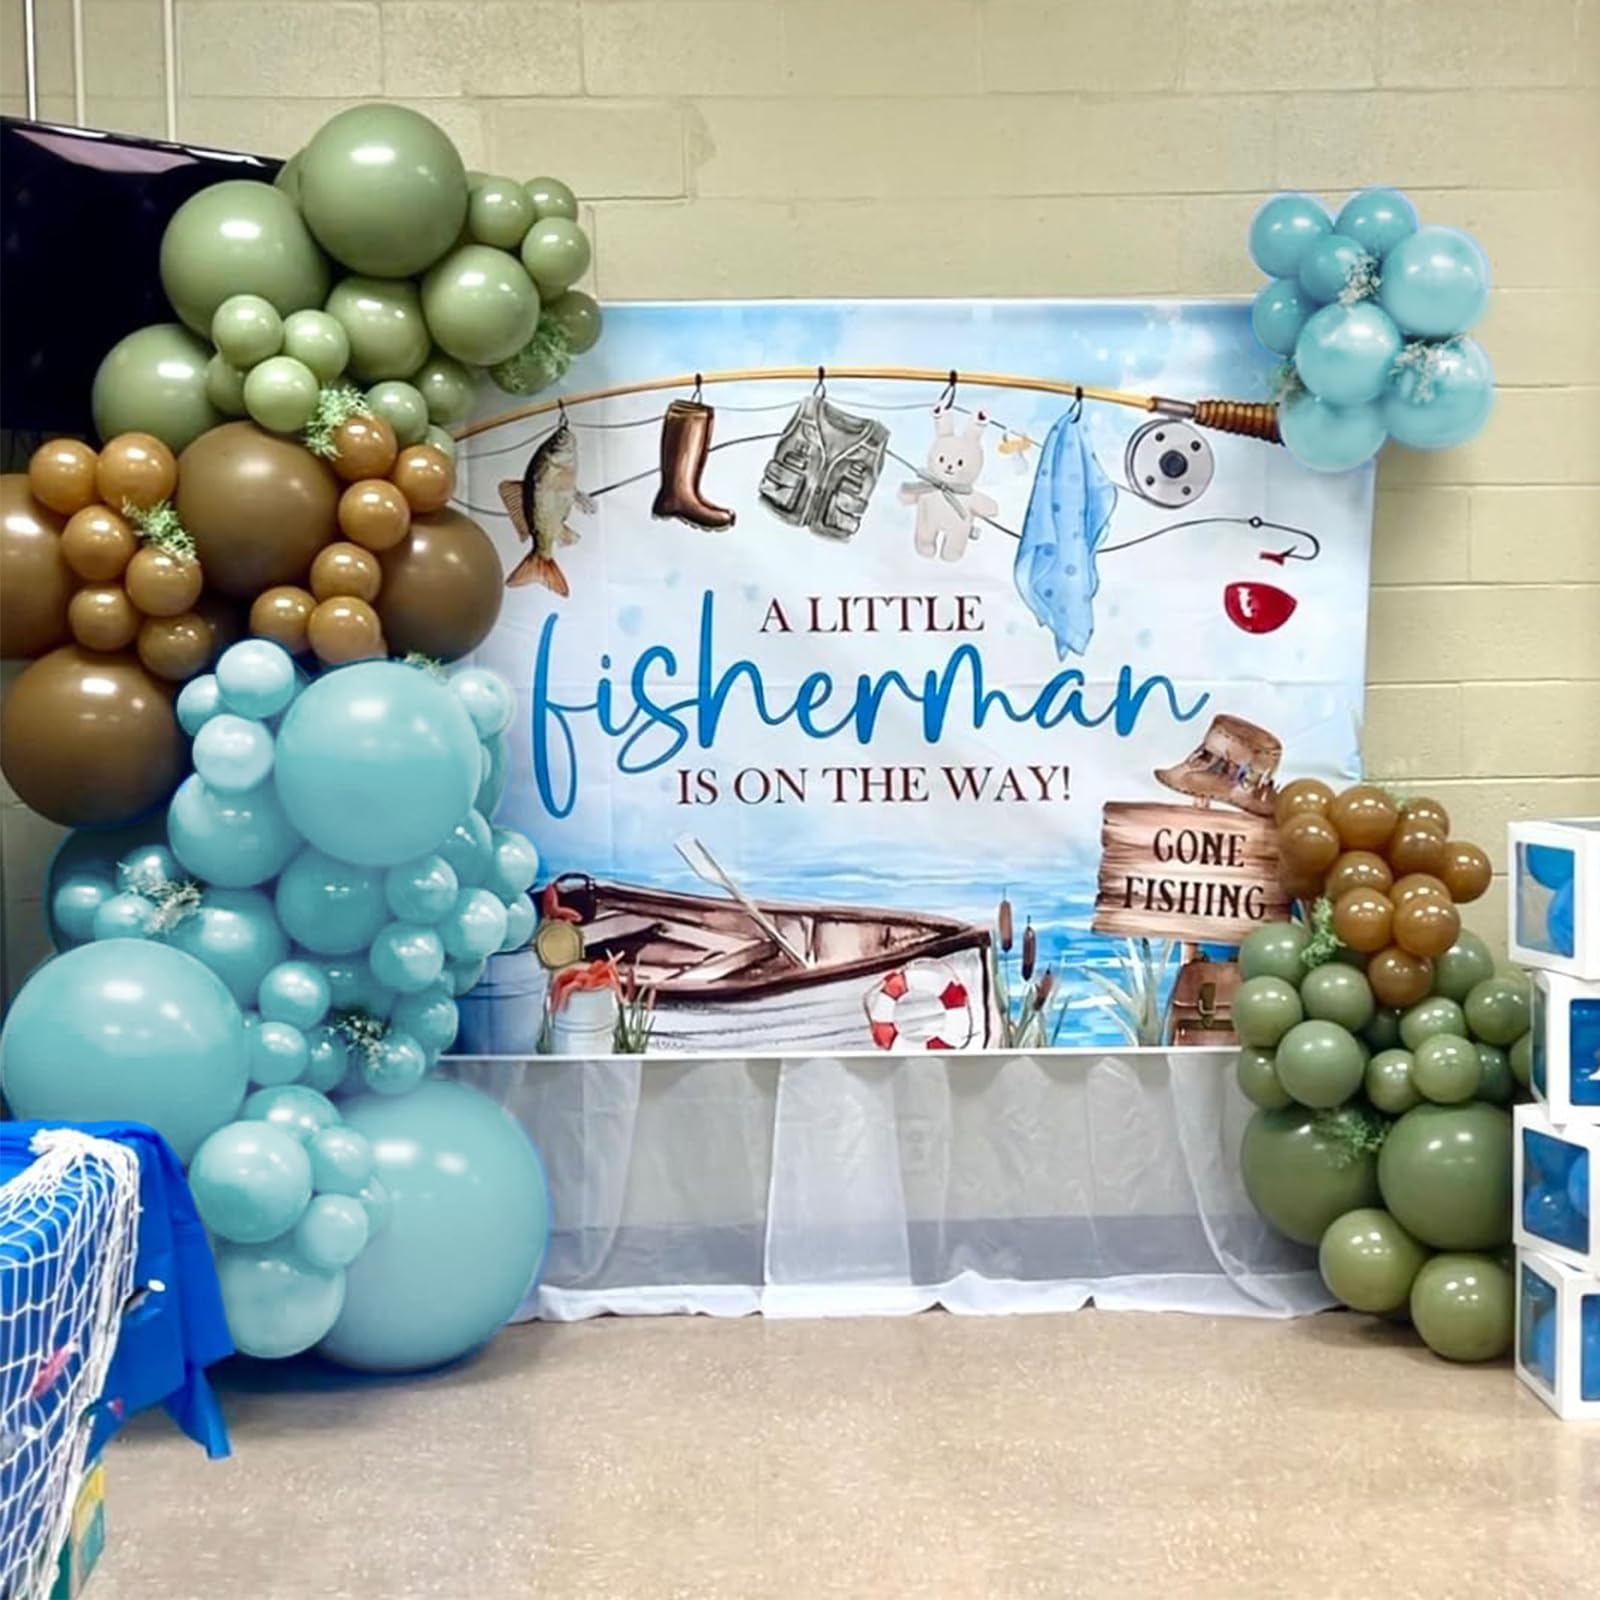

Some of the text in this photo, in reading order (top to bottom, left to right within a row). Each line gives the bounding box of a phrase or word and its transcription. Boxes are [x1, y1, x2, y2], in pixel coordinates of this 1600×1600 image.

[760, 597, 985, 632] A LITTLE
[533, 589, 1209, 818] fisherman
[678, 766, 1072, 804] IS ON THE WAY!
[1153, 829, 1247, 868] GONE
[1122, 876, 1266, 920] FISHING
